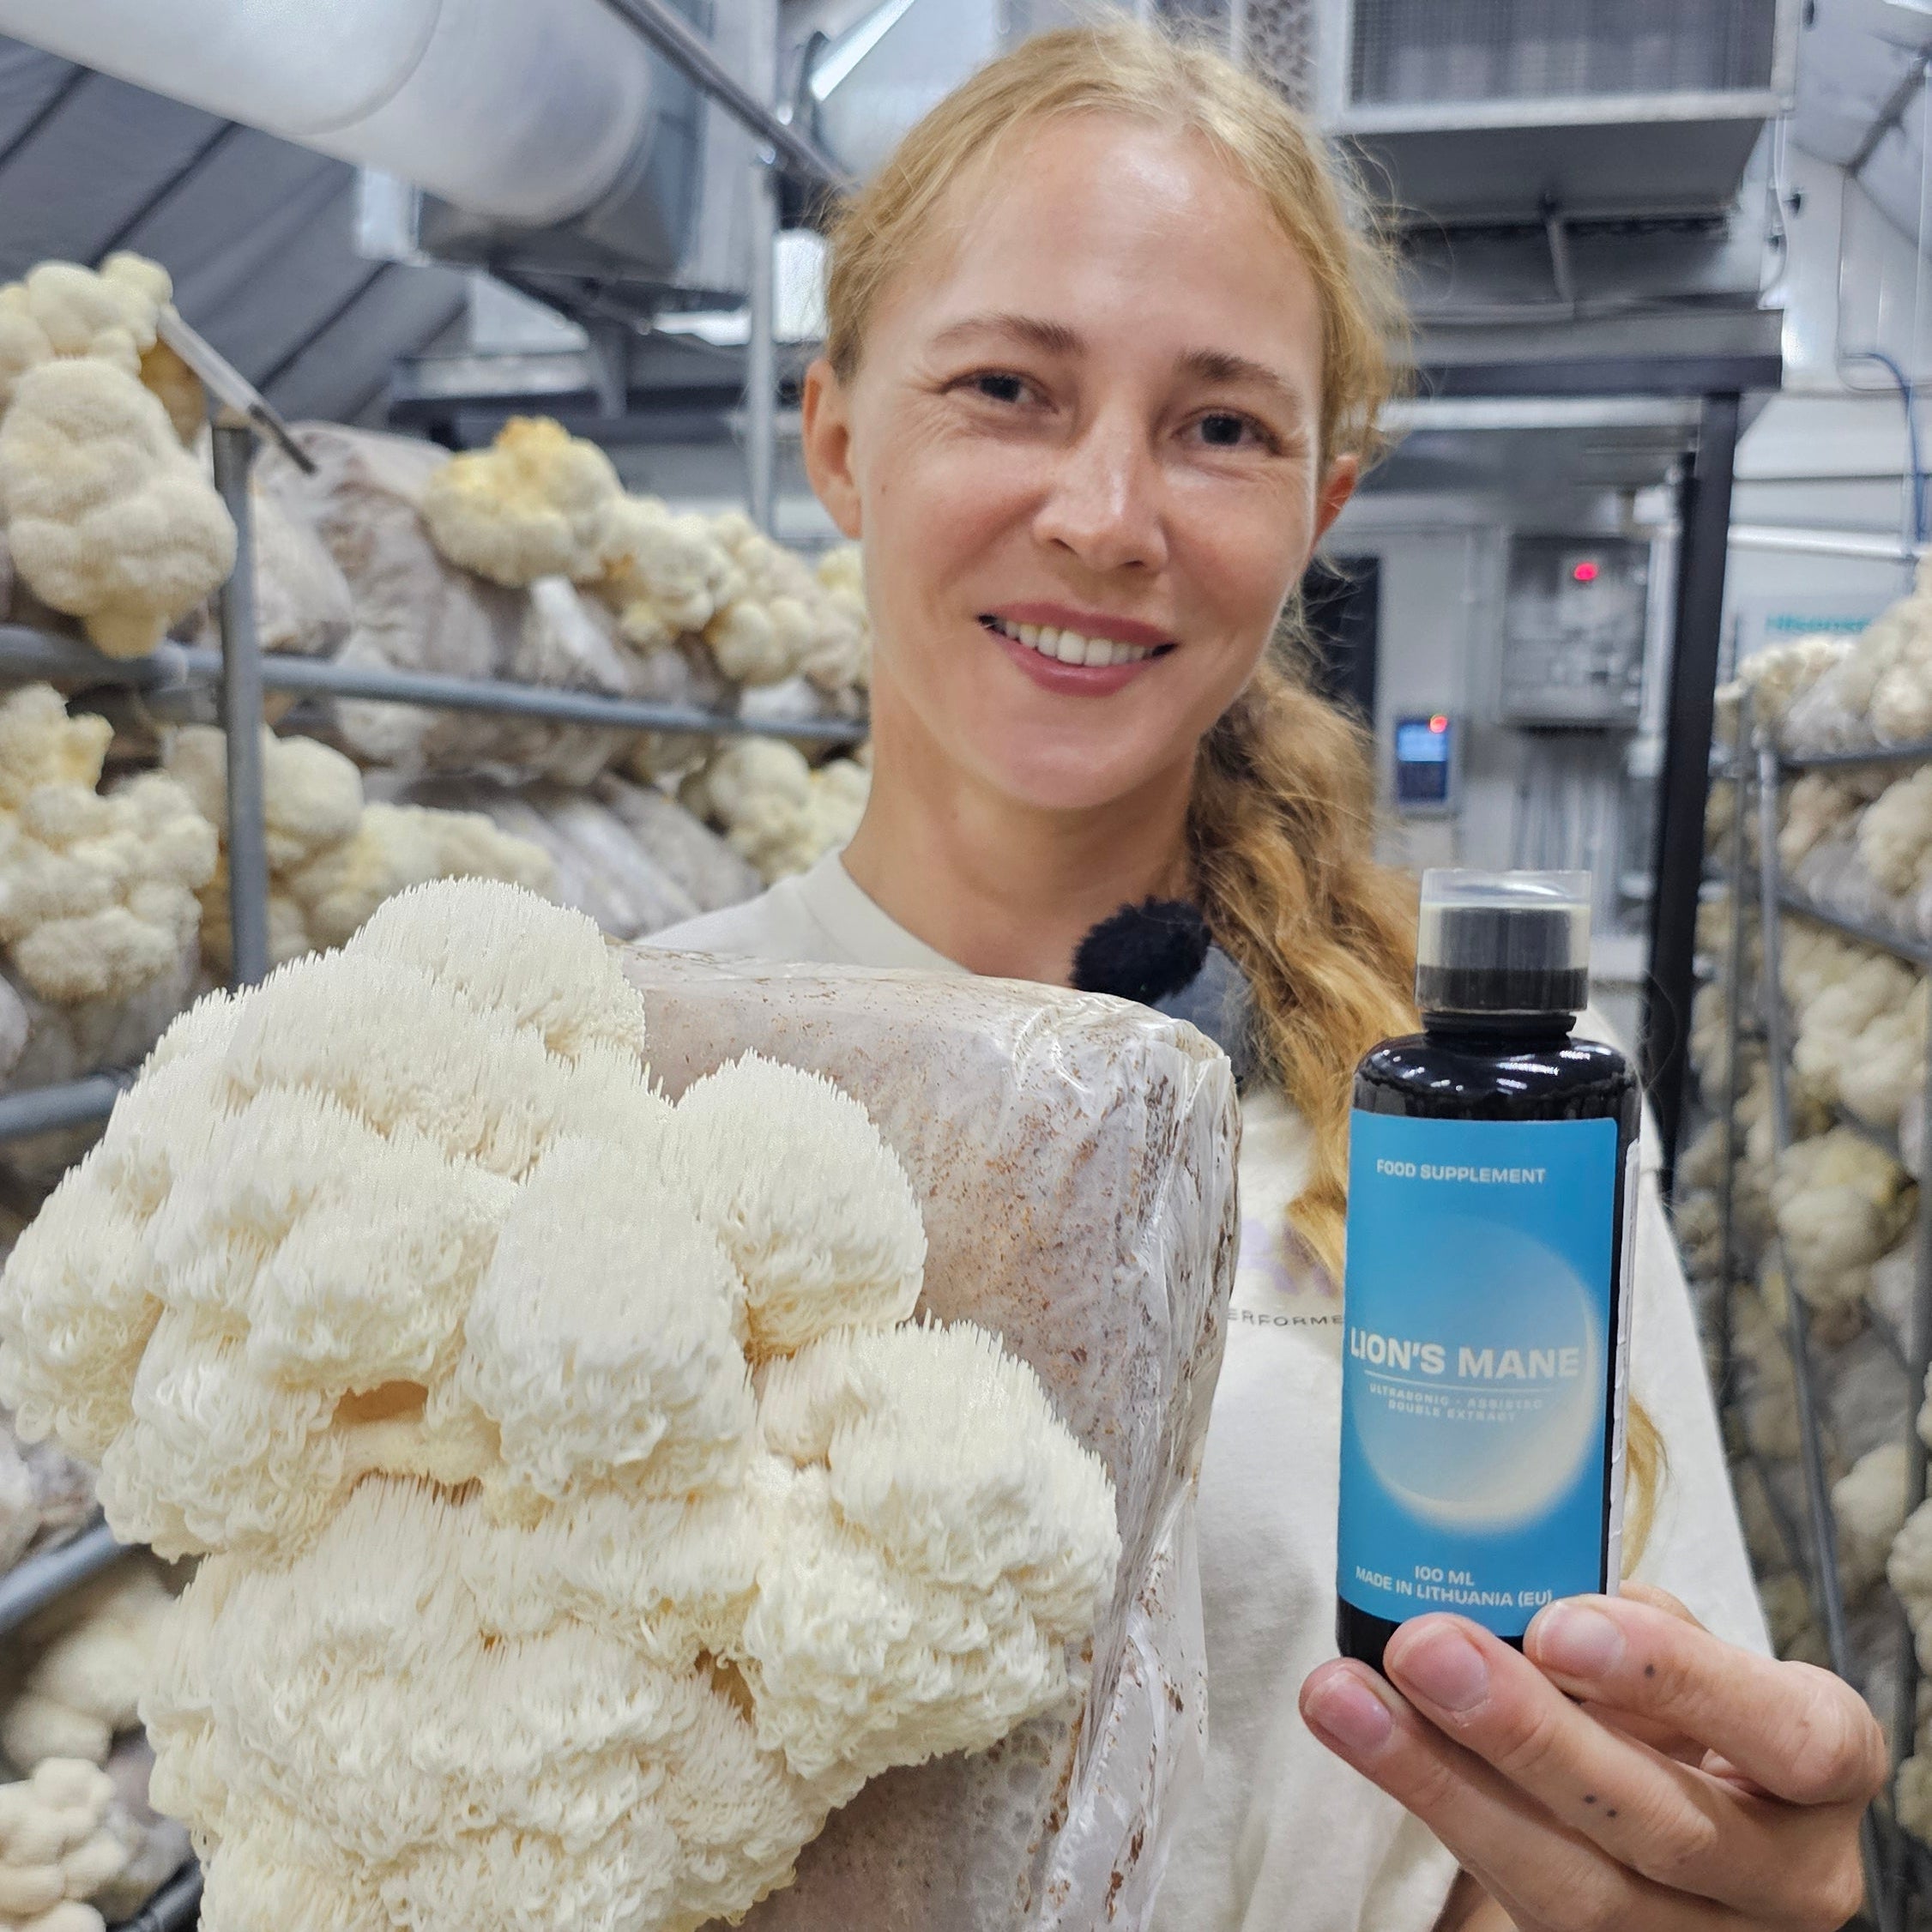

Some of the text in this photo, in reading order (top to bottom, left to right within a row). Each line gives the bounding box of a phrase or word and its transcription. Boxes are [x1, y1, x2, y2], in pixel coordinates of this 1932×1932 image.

[1376, 1158, 1546, 1185] FOOD SUPPLEMENT
[1349, 1326, 1580, 1380] LION'S MANE
[1355, 1565, 1553, 1608] MADE IN LITHUANIA (EU)
[1415, 1566, 1476, 1586] 100 ML
